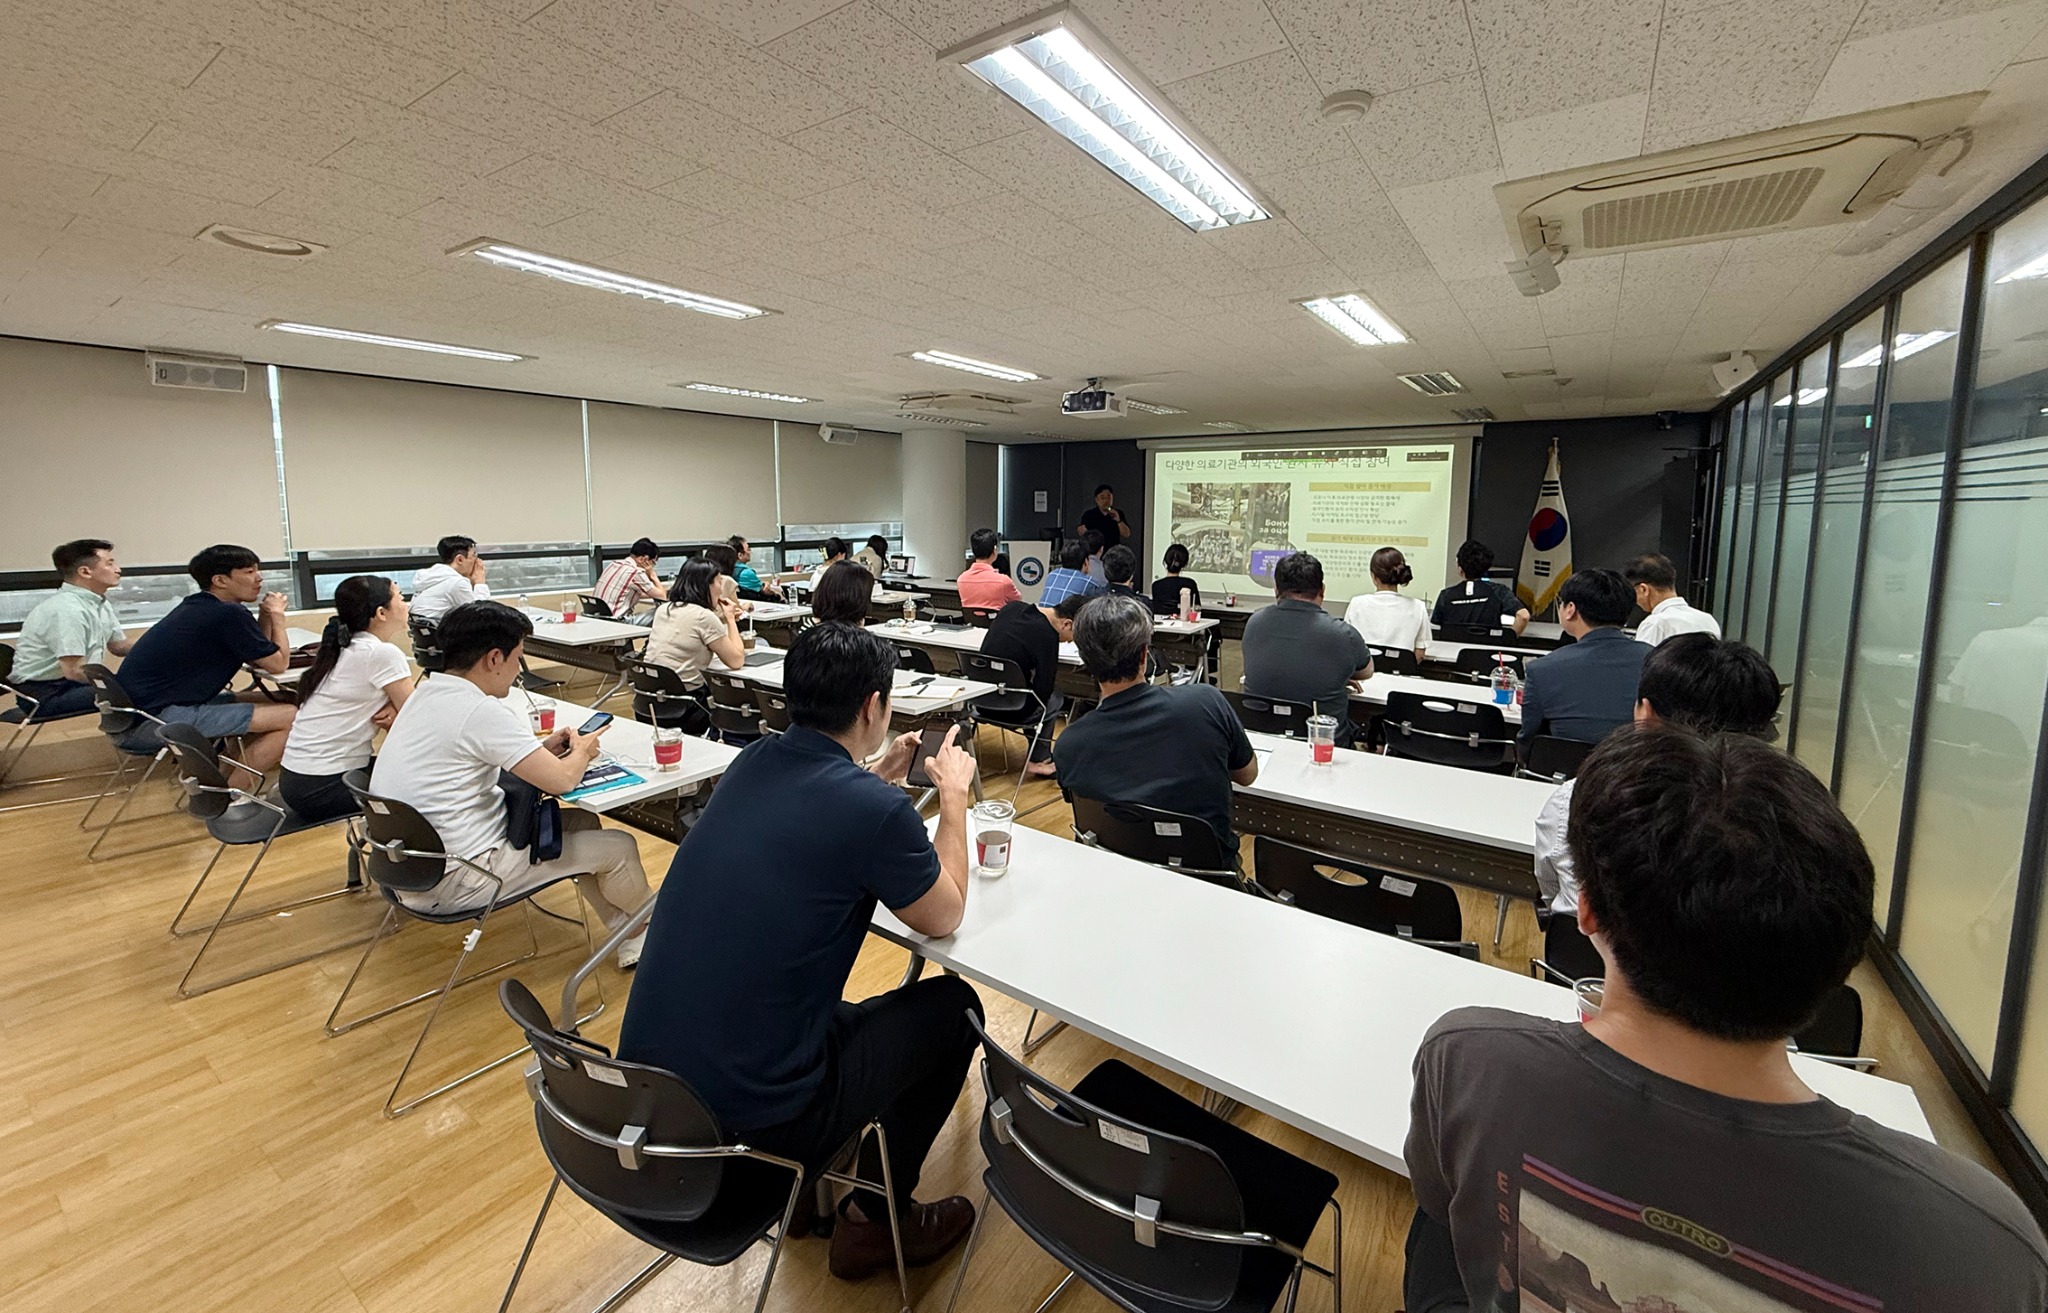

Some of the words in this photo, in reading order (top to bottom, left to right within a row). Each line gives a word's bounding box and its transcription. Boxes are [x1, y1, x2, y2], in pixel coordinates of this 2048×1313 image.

[1165, 459, 1194, 471] 다양한
[1196, 458, 1247, 470] 의료기관의
[1264, 518, 1289, 528] Бону
[1648, 1212, 1721, 1251] OUTRO
